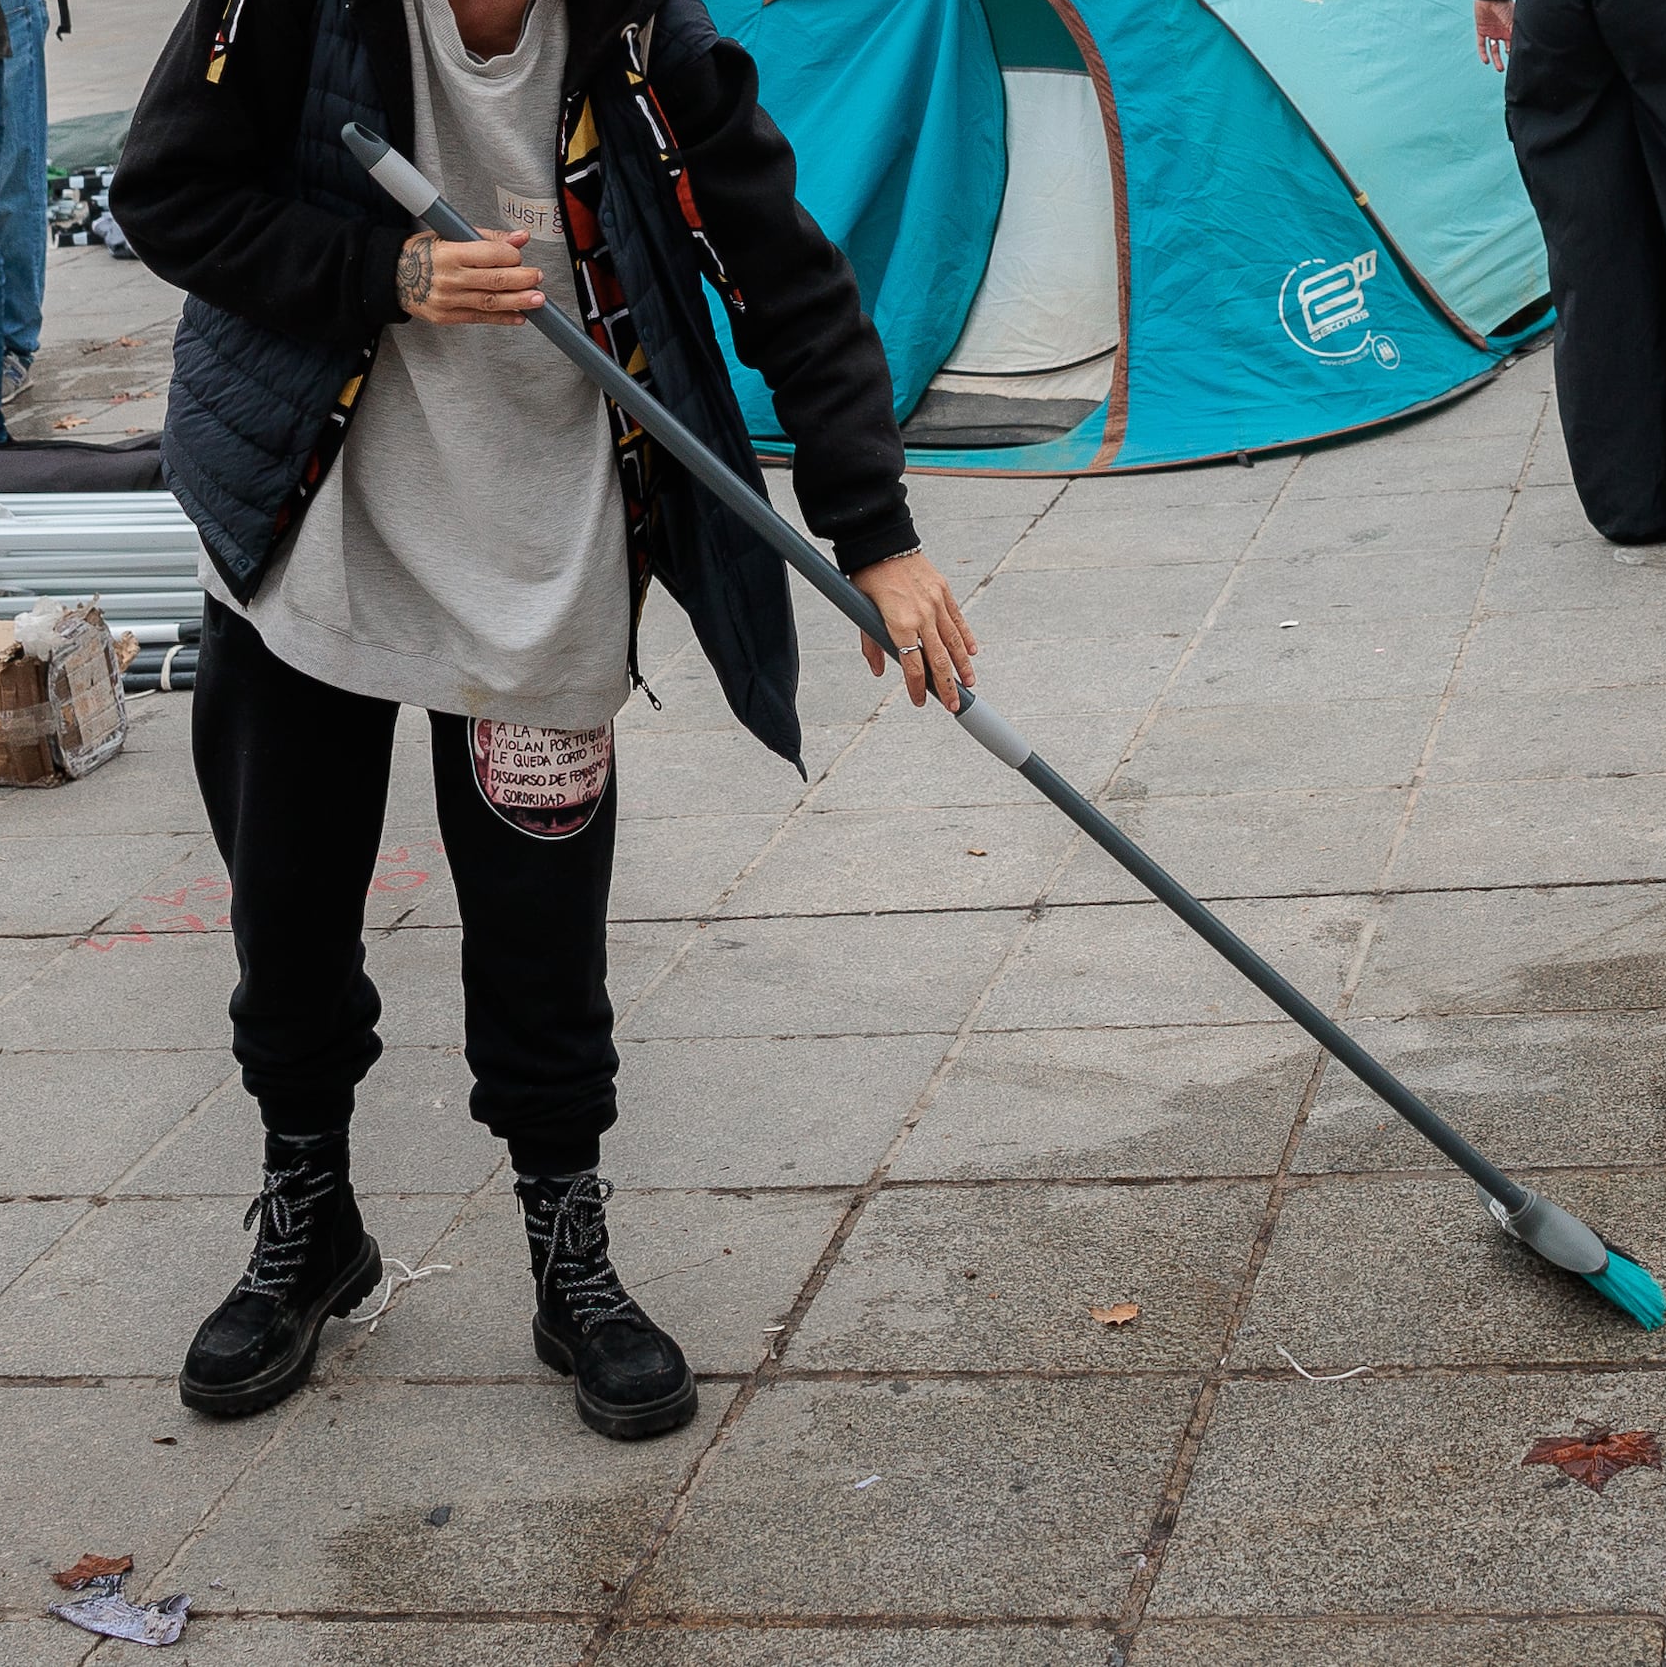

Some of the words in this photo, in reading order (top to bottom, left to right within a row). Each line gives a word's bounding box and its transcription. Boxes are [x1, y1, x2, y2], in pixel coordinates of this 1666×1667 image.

[502, 199, 548, 228] JUST
[496, 722, 507, 735] A
[513, 724, 531, 738] LA
[494, 737, 544, 753] VIOLAN
[550, 737, 572, 752] POR
[573, 733, 588, 746] TU
[491, 749, 508, 764] LE
[513, 753, 551, 768] QUEDA
[556, 747, 587, 765] CORTO
[590, 741, 603, 755] TU
[491, 768, 546, 787] DISCURSO
[548, 772, 567, 787] DE
[491, 784, 500, 798] Y
